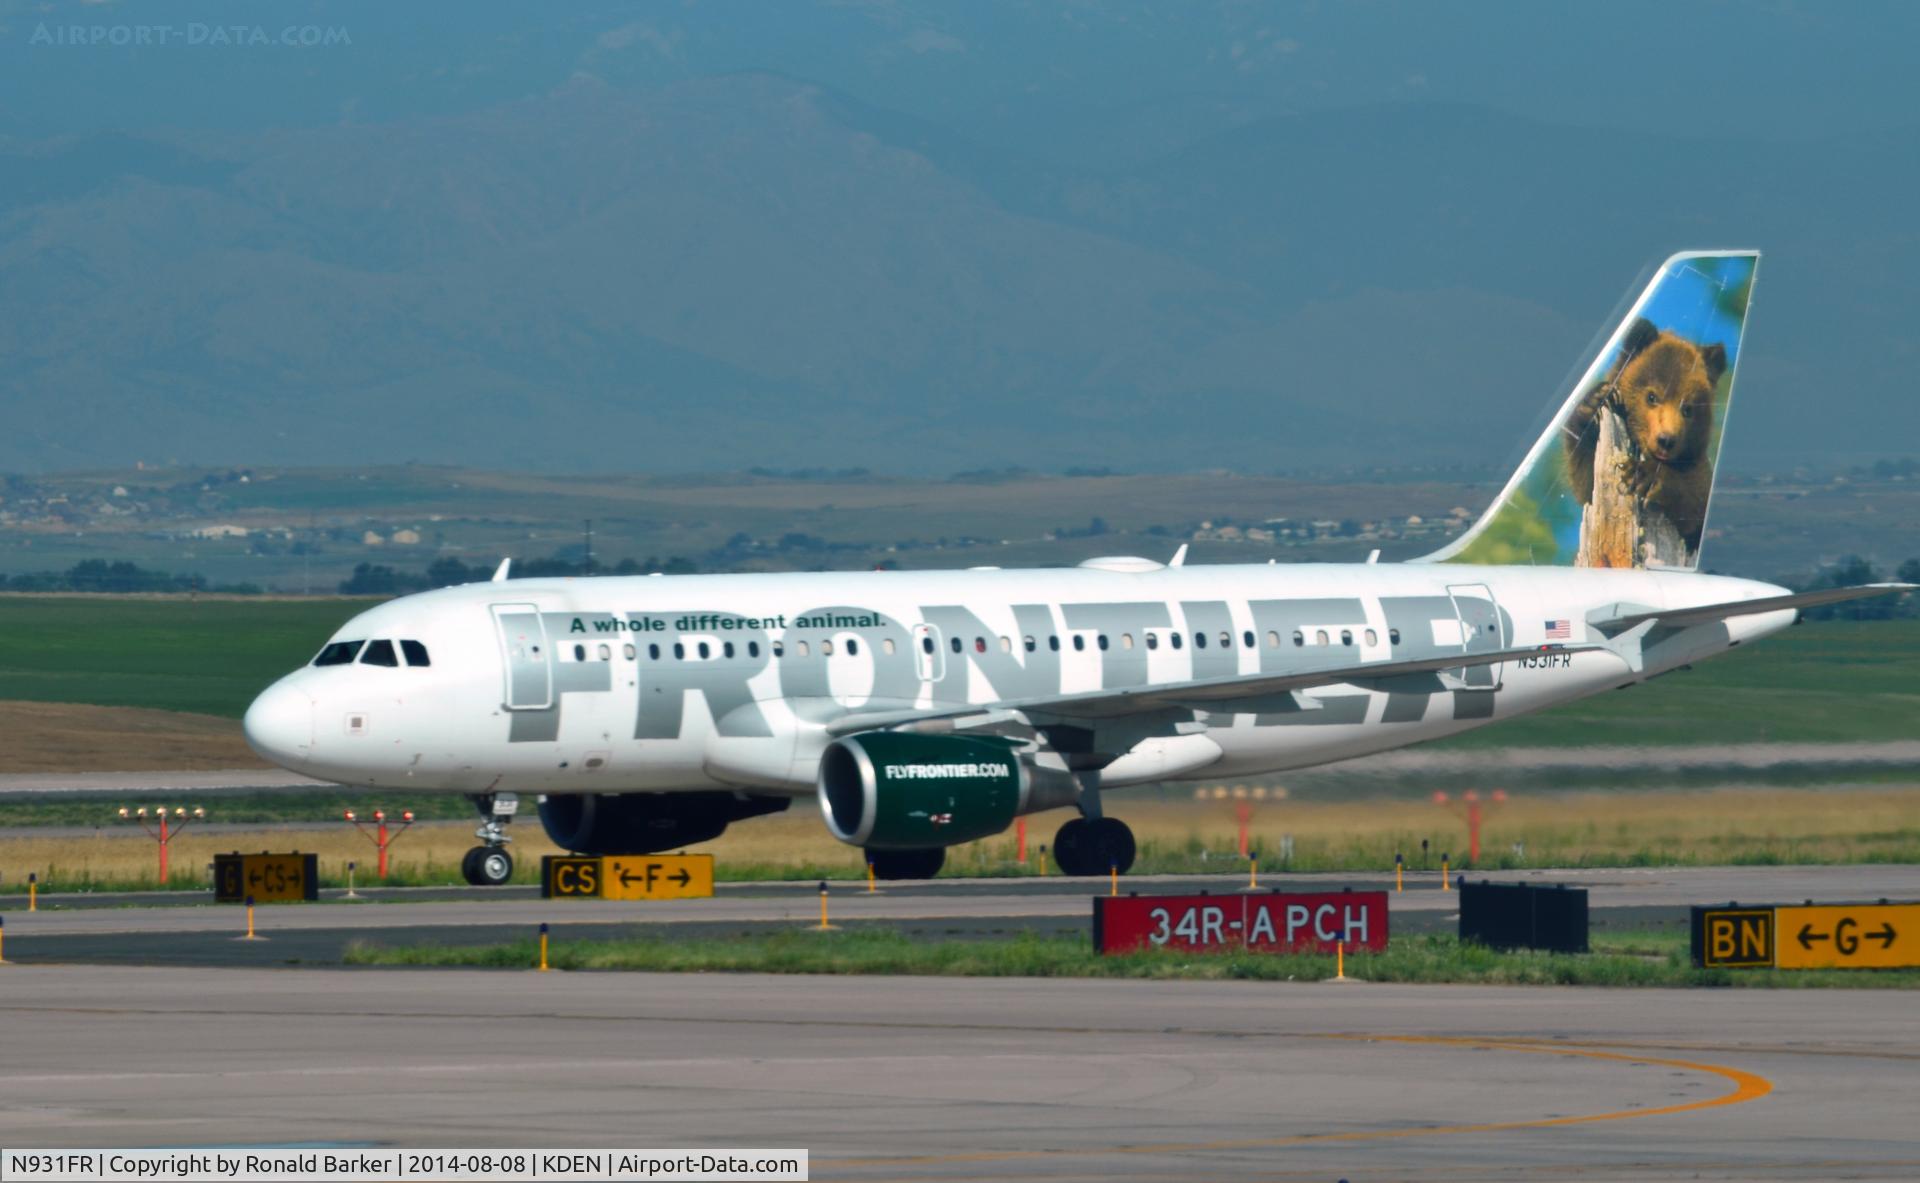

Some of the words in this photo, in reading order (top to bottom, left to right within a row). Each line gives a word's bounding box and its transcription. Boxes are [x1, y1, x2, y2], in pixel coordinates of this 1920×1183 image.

[570, 617, 586, 633] A
[593, 617, 666, 632] whole
[675, 614, 788, 631] different
[796, 612, 886, 628] animal.
[1518, 652, 1571, 668] N931FR
[885, 763, 1009, 779] FLYFRONTIER.COM
[264, 863, 285, 893] CS
[557, 865, 595, 893] CS
[646, 864, 663, 893] F
[1712, 919, 1766, 958] BN
[1835, 917, 1859, 956] G
